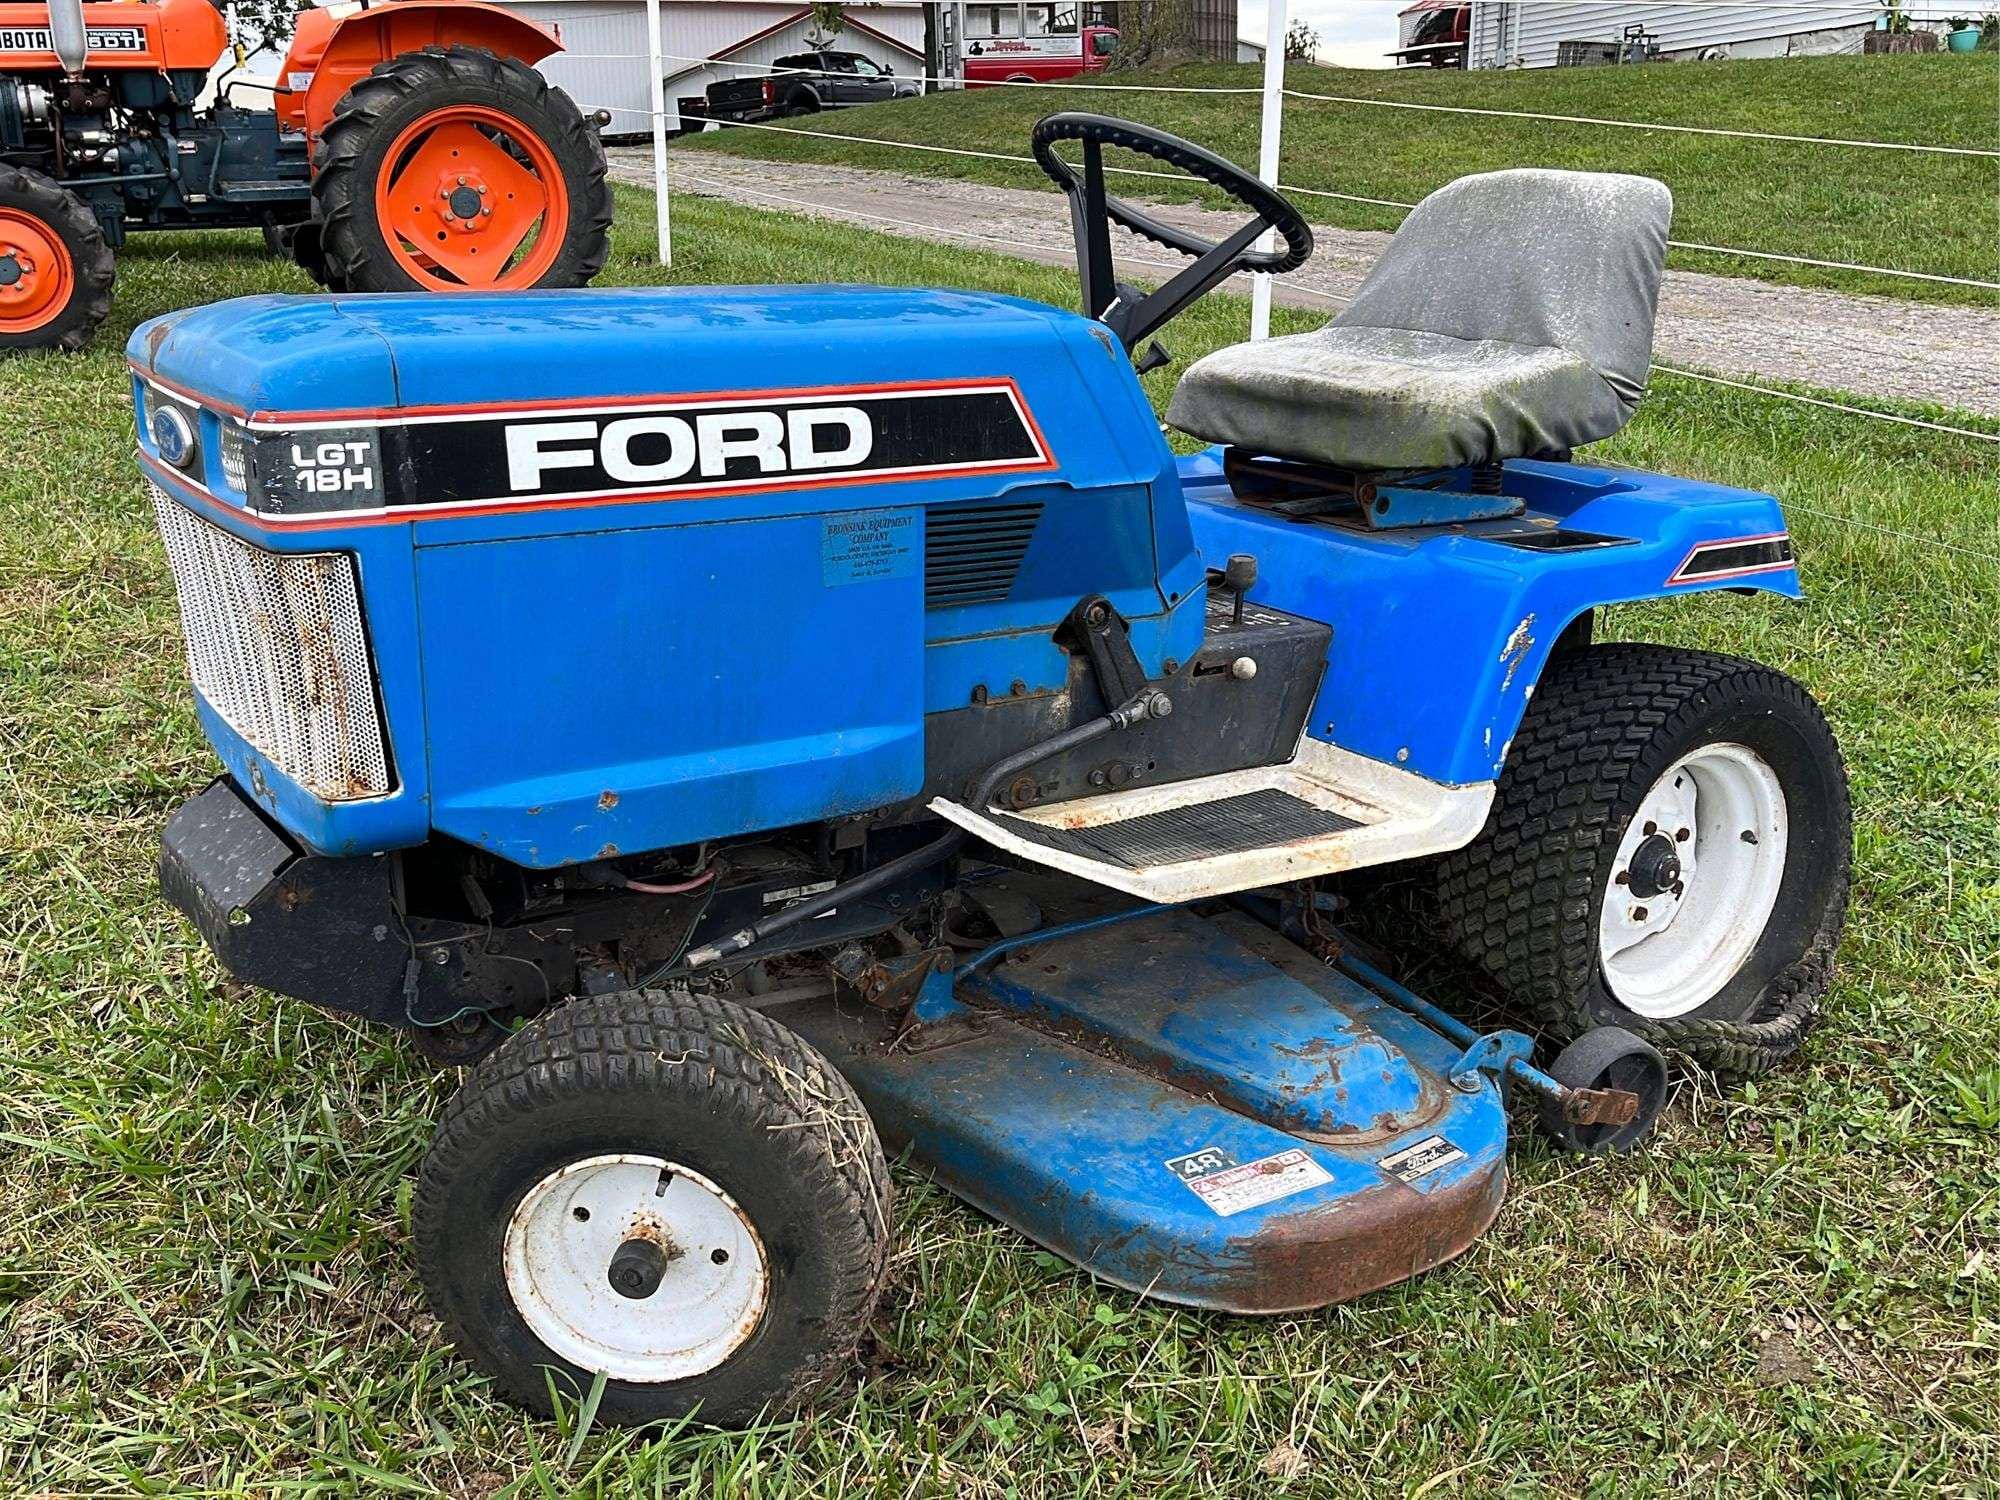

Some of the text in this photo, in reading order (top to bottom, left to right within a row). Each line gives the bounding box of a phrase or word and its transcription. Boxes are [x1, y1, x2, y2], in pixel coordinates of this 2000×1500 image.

[290, 442, 371, 467] LGT
[504, 406, 873, 491] FORD
[296, 467, 374, 493] 18H
[869, 517, 912, 531] EQUIPMENT
[852, 532, 889, 544] COMPANY
[1406, 1148, 1444, 1170] Ford
